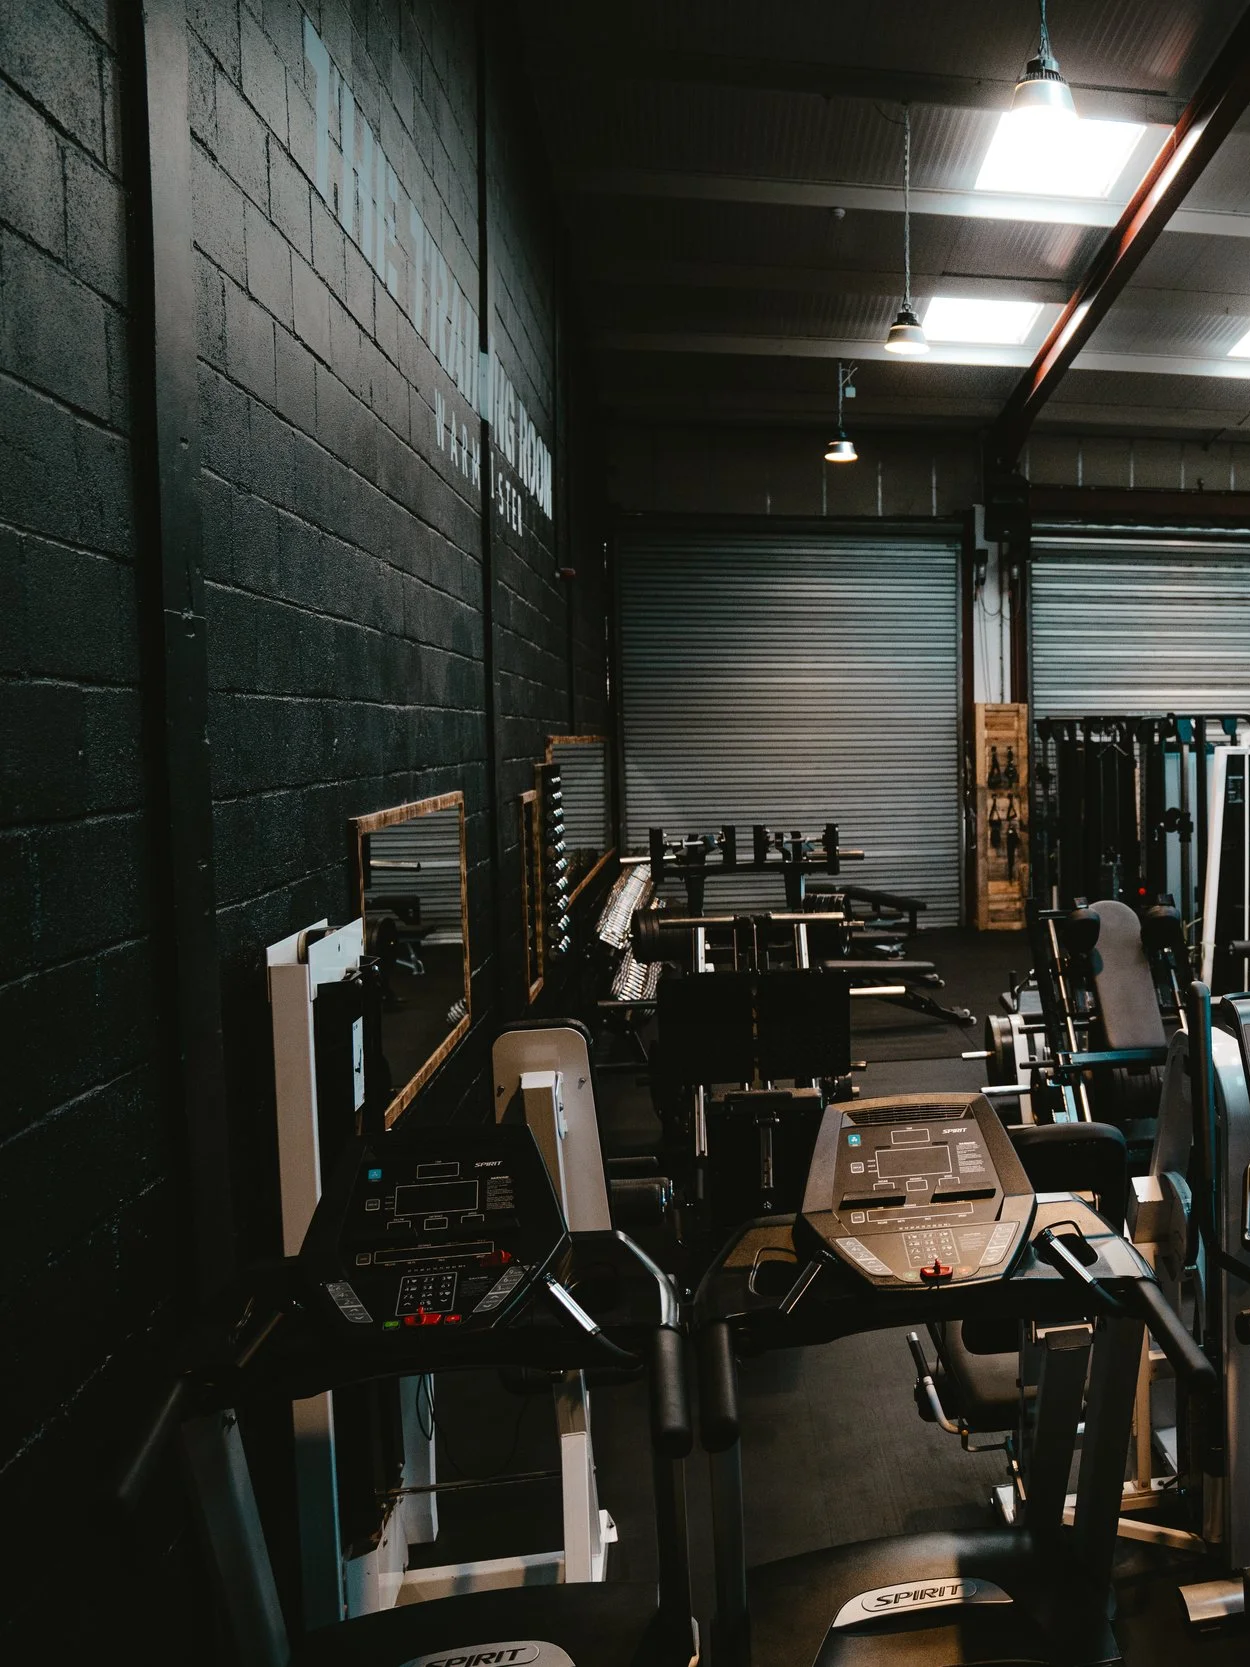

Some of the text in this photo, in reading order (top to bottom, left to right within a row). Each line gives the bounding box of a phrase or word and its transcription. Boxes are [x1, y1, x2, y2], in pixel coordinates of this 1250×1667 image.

[304, 14, 399, 299] THE
[519, 400, 553, 521] ROOM
[942, 1127, 968, 1135] SPIRIT
[474, 1160, 503, 1168] SPIRIT
[874, 1583, 965, 1608] SPIRIT
